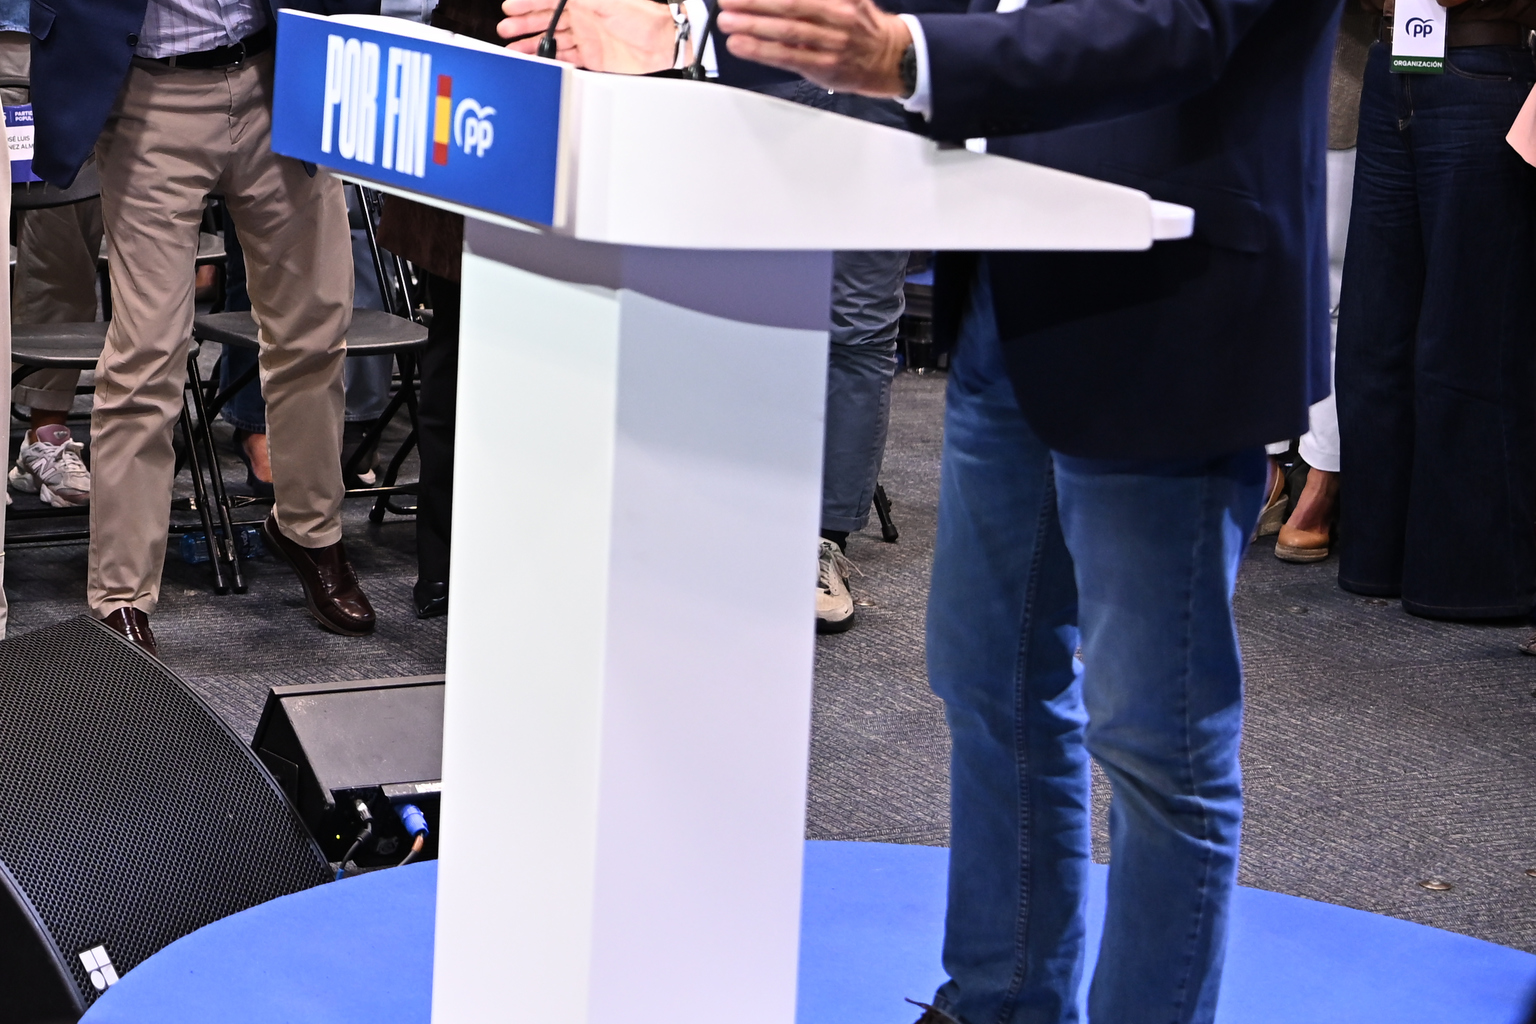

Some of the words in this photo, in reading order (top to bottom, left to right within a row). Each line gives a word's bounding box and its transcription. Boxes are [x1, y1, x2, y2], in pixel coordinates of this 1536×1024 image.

[1393, 59, 1443, 68] ORGANIZACIÓN
[321, 34, 380, 165] POR
[382, 46, 432, 178] FIN
